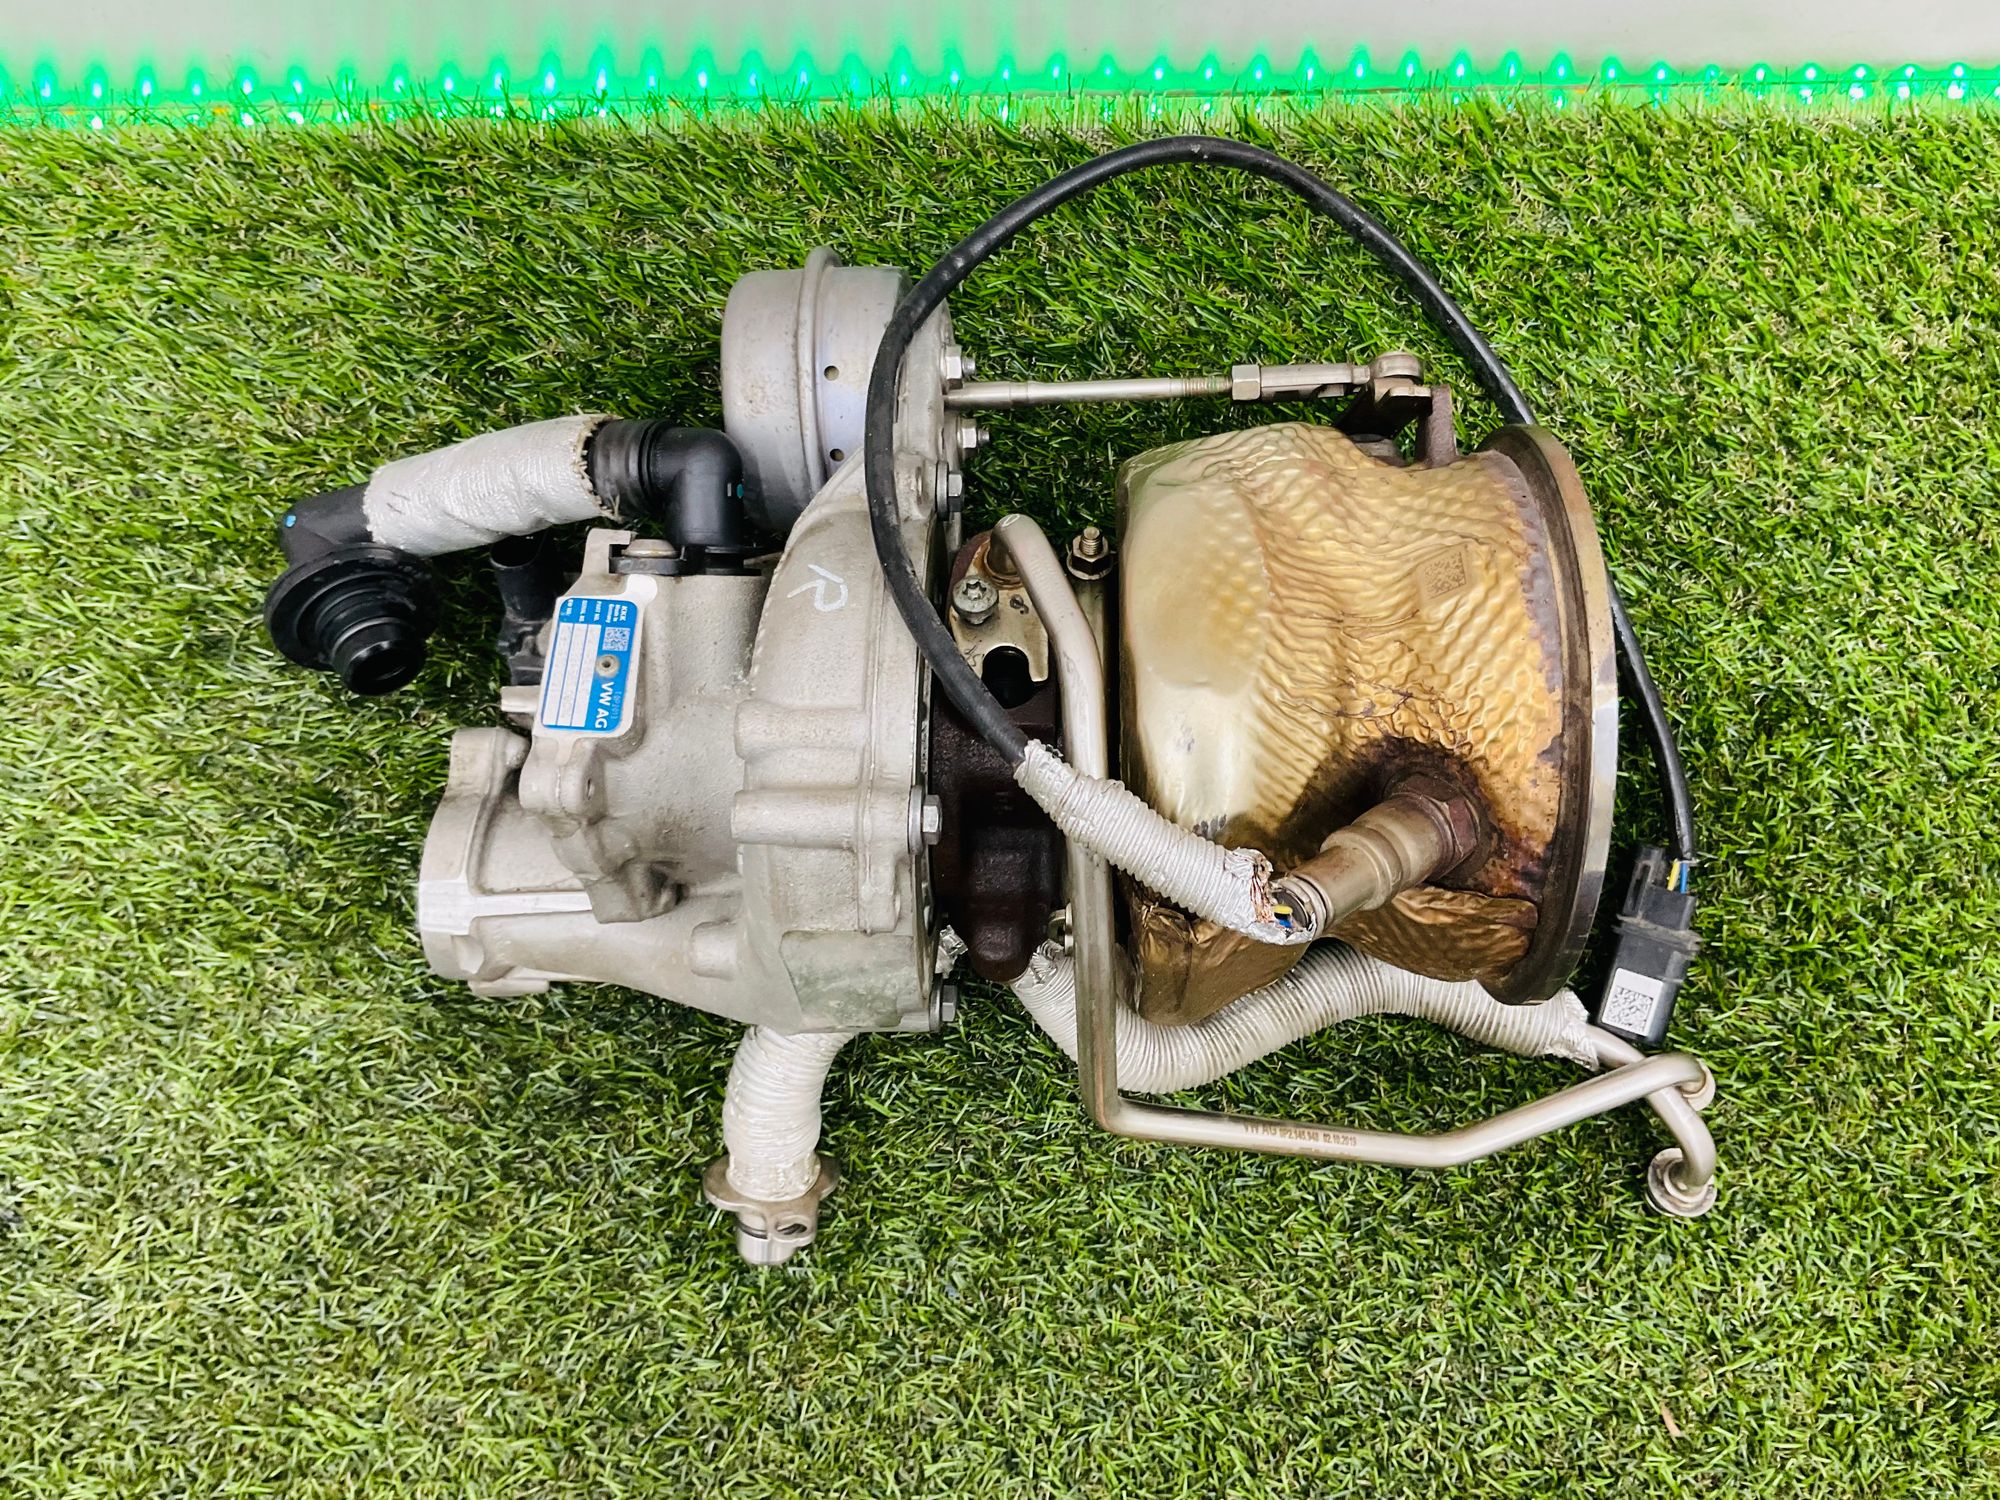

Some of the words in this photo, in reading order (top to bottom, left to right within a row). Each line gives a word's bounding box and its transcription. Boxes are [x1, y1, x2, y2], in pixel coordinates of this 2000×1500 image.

[620, 605, 628, 622] KKK
[599, 682, 614, 705] VW
[595, 708, 609, 728] AG
